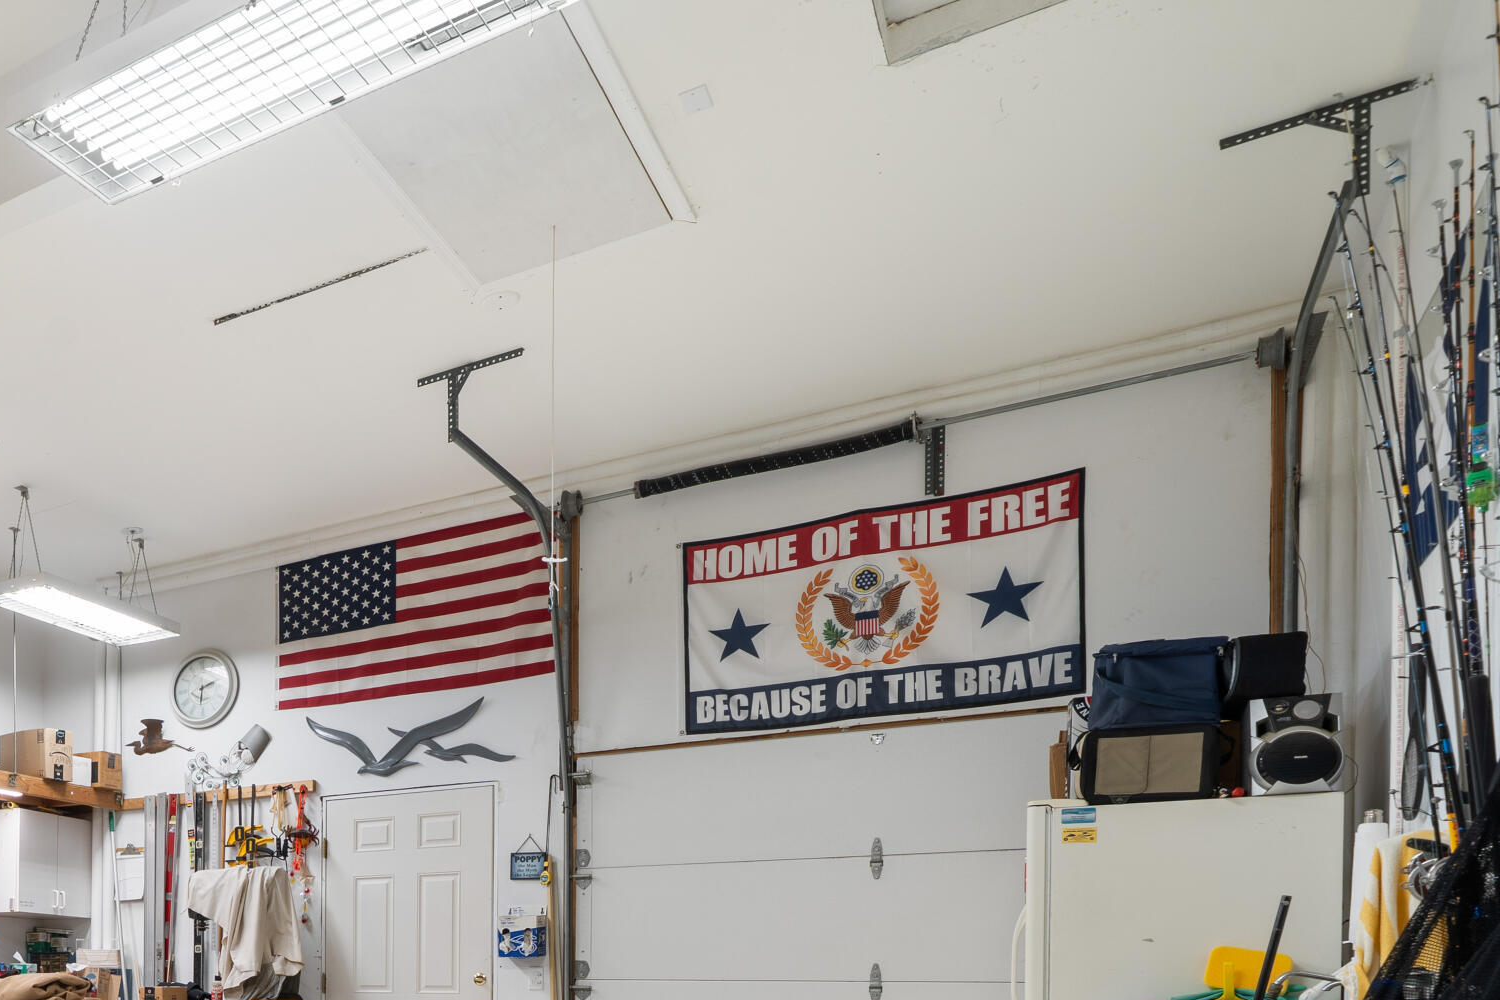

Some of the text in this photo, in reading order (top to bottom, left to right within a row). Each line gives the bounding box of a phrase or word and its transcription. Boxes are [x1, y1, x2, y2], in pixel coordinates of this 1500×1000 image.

[693, 481, 1070, 581] HOME OF THE FREE
[696, 651, 1073, 724] BECAUSE OF THE BRAVE
